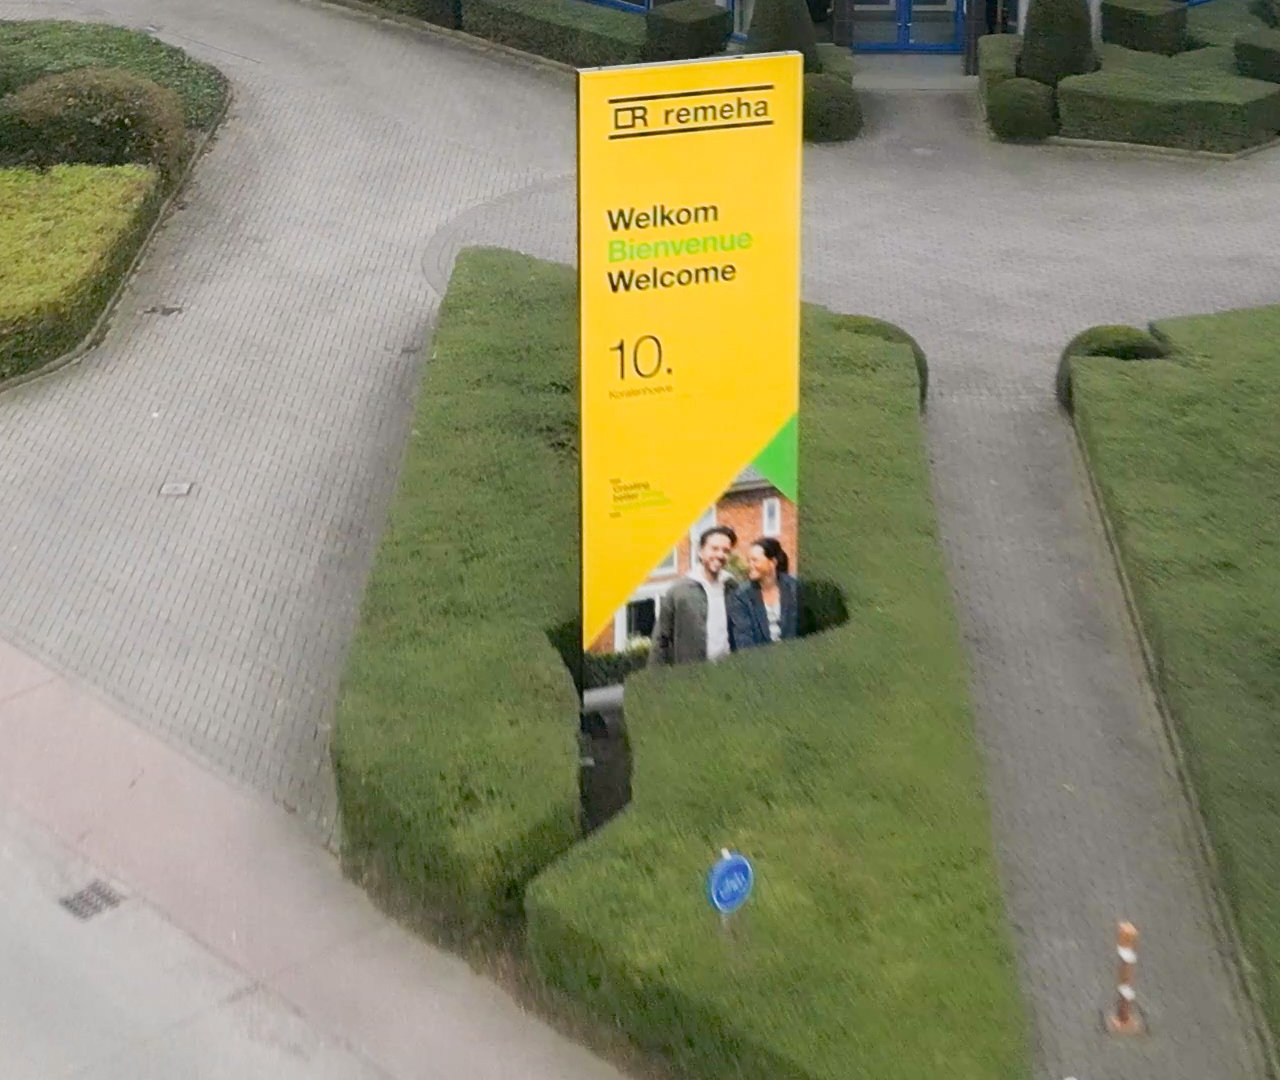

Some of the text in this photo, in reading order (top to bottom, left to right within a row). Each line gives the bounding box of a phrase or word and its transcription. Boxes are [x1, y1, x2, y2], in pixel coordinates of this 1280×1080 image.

[664, 97, 769, 126] remeha
[607, 204, 719, 232] Welkom
[608, 232, 753, 263] Bienvenue
[607, 264, 737, 294] Welcome
[609, 335, 672, 380] 10.
